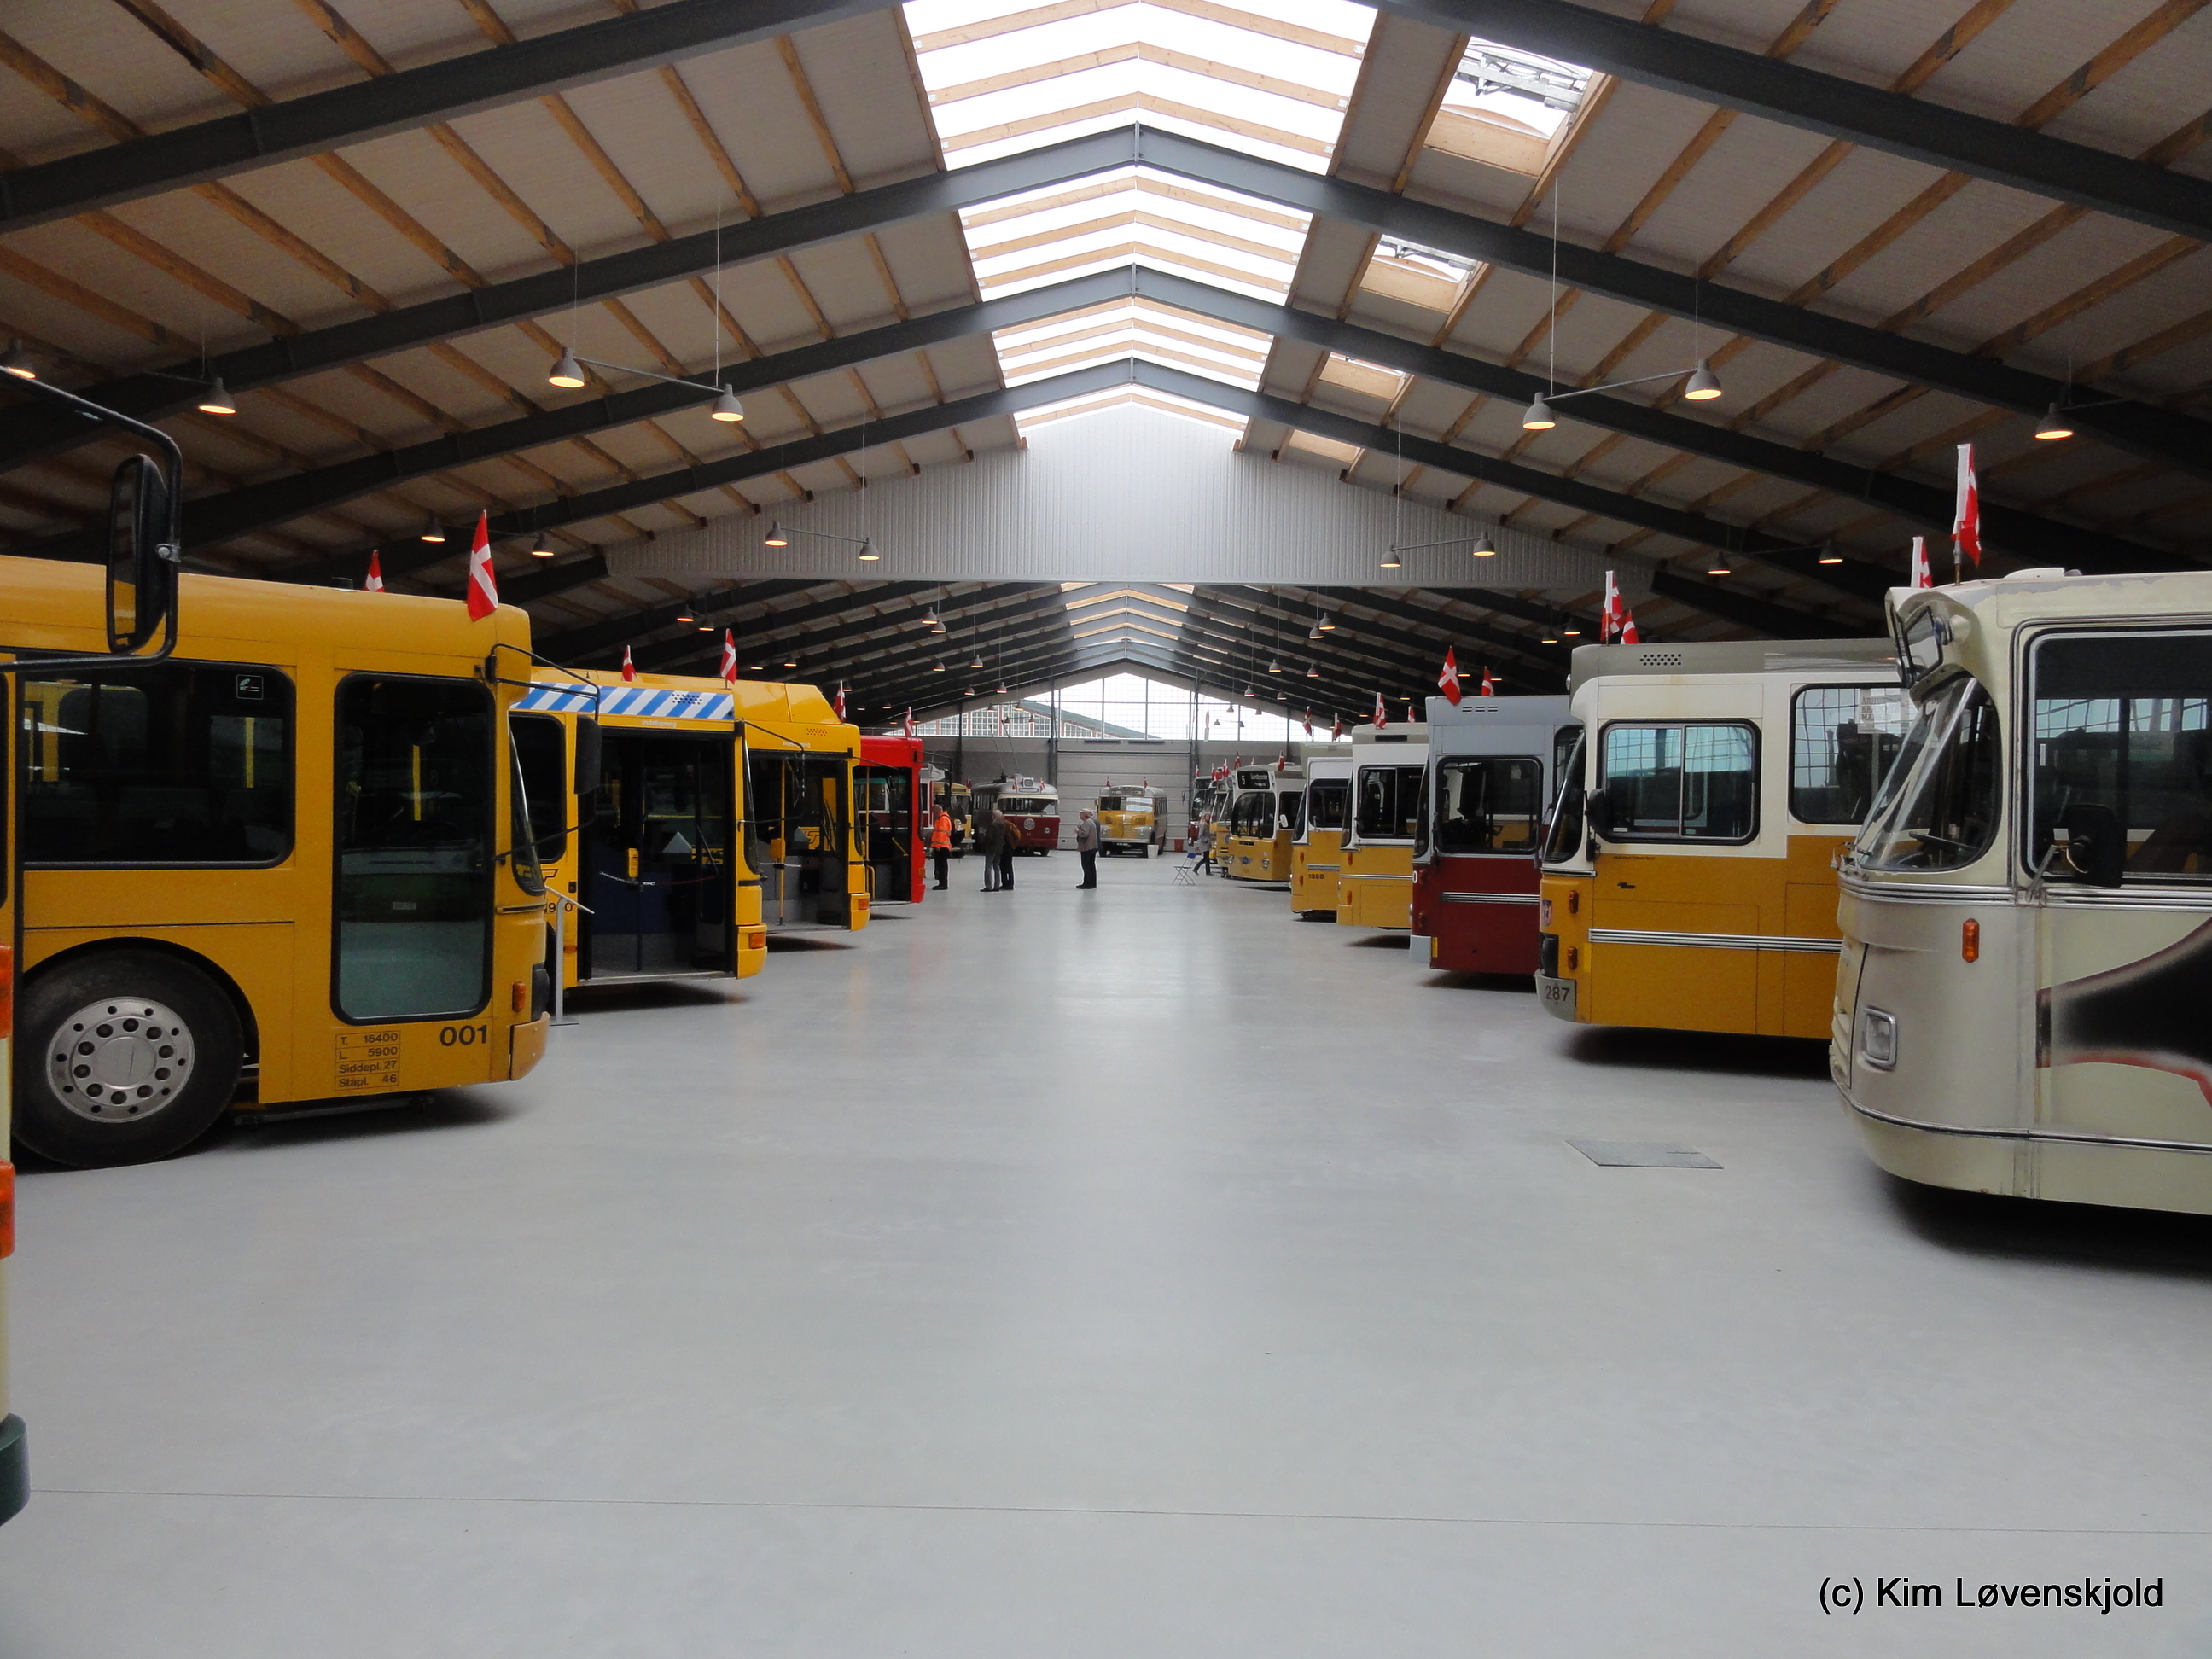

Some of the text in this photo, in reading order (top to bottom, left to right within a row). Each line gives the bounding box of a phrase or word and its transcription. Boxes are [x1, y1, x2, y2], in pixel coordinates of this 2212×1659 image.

[1545, 985, 1570, 1002] 287
[364, 1033, 399, 1044] 16400
[439, 1024, 488, 1047] 001
[368, 1047, 398, 1057] 5900
[339, 1060, 398, 1074] Siddepl. 27
[382, 1074, 397, 1084] 46
